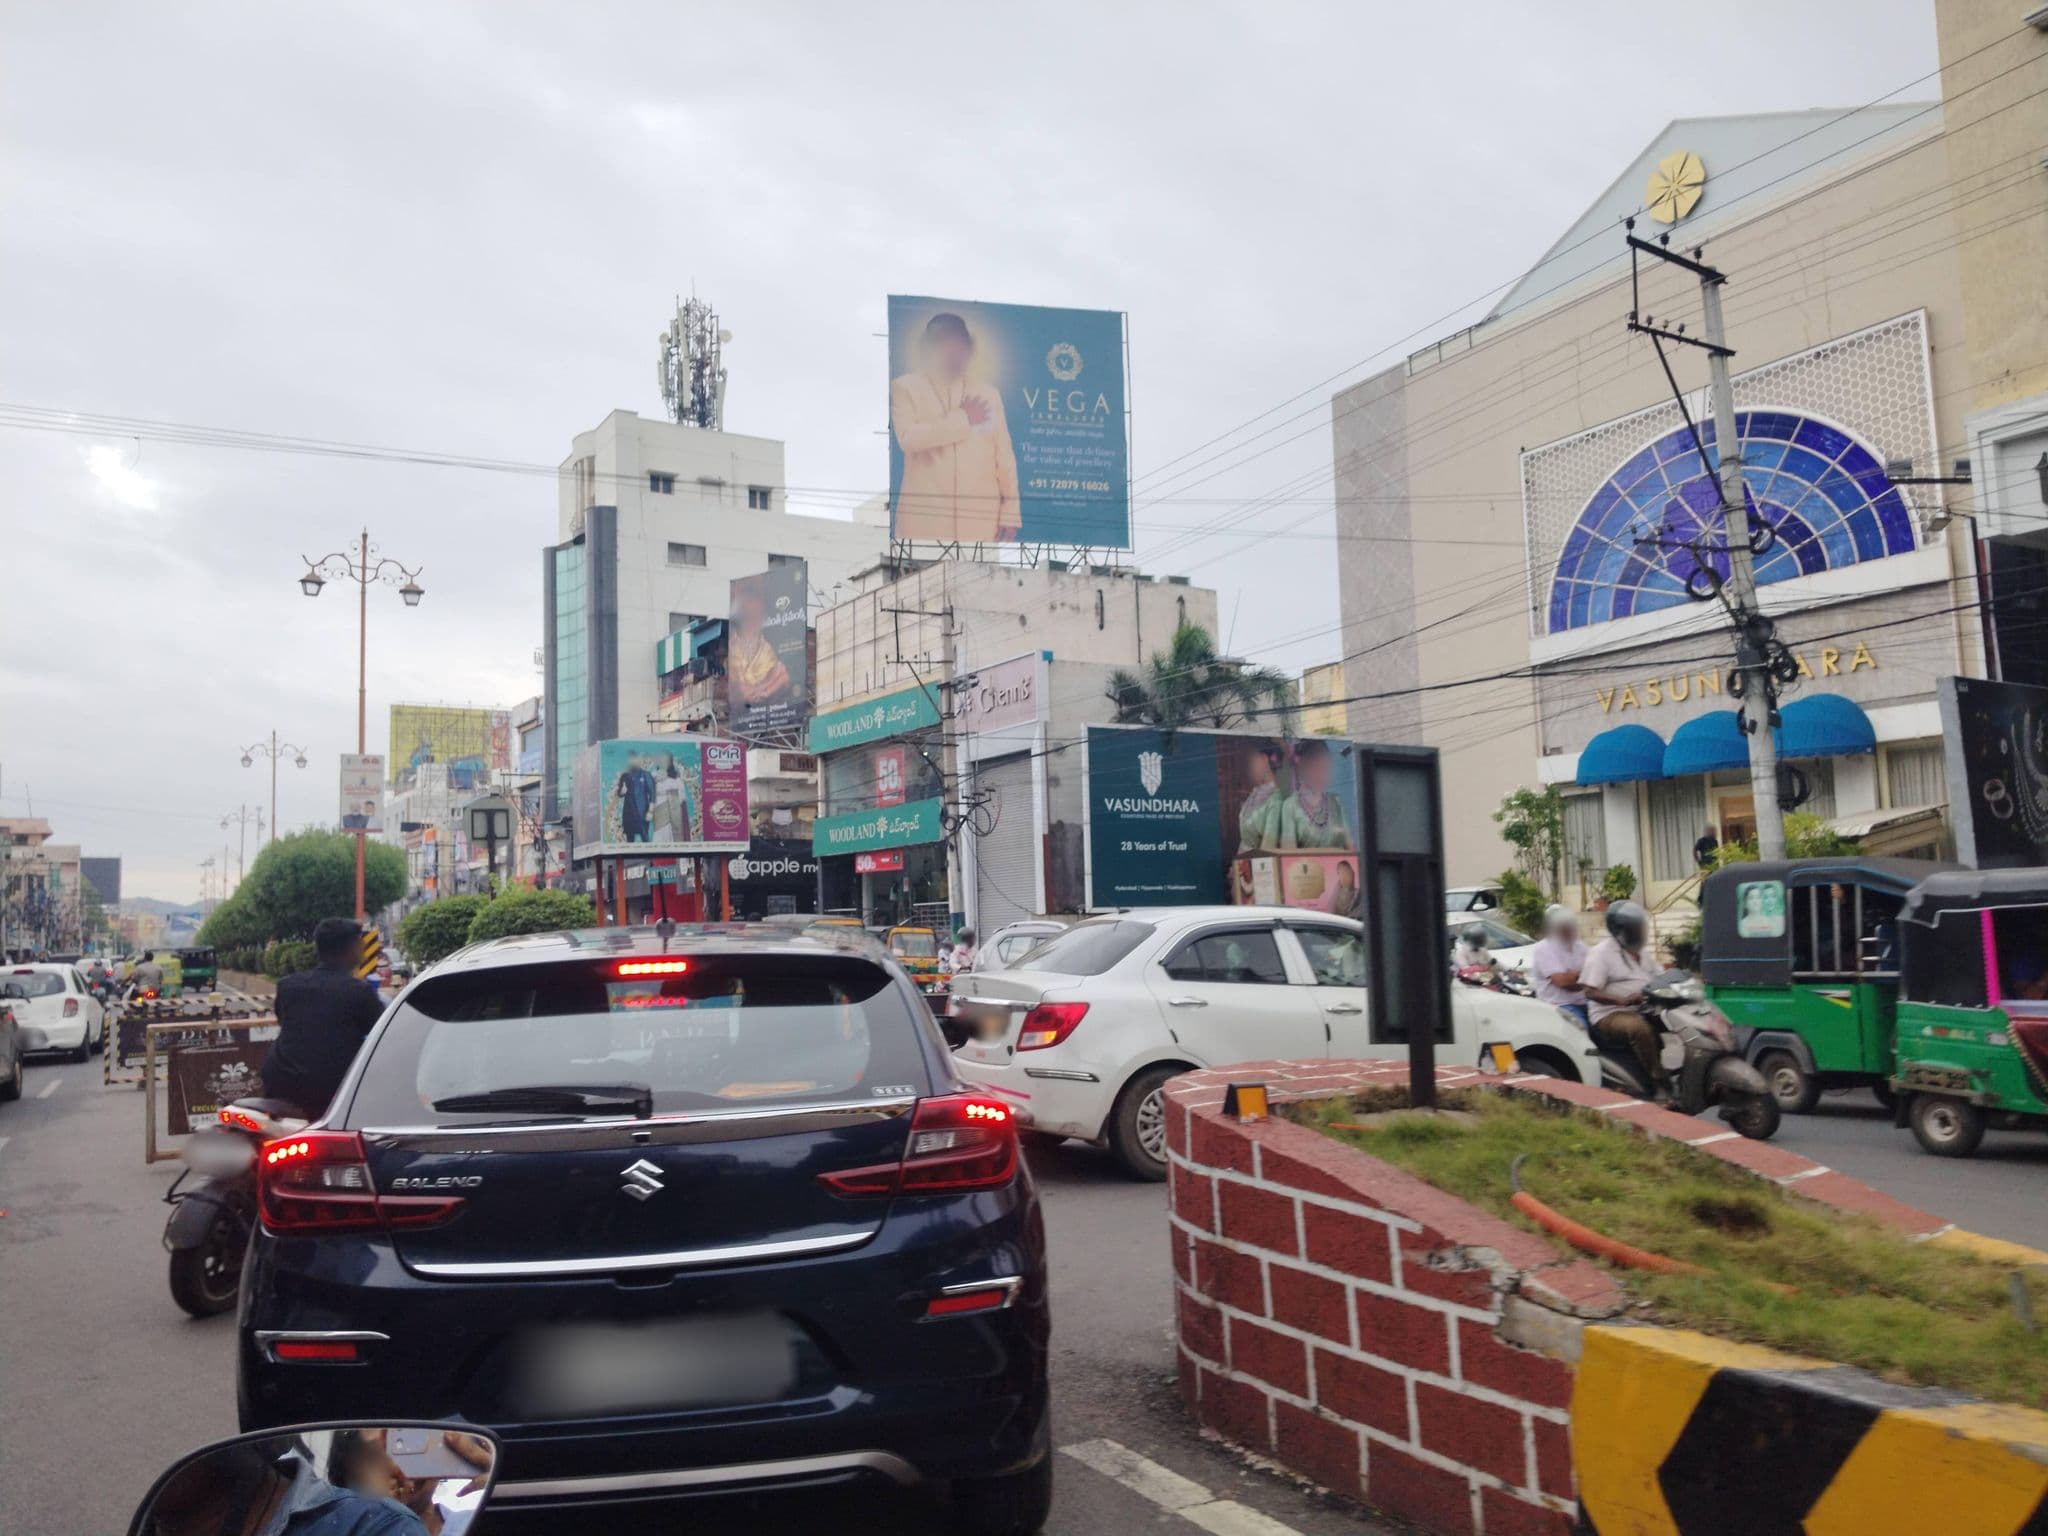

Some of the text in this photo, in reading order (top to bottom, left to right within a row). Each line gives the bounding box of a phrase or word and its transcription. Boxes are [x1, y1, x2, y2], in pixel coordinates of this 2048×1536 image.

[1023, 387, 1110, 414] VEGA
[1029, 479, 1047, 489] +91
[1597, 641, 1878, 714] VASUNARA
[827, 714, 874, 738] WOODLAND
[709, 746, 740, 760] CMR
[1105, 798, 1199, 813] VASUNDHARA
[829, 822, 876, 843] WOODLAND
[1121, 841, 1187, 851] 28 Years of Trust
[750, 857, 800, 876] apple
[192, 1104, 217, 1113] EXCLU
[392, 1176, 483, 1189] BALENO
